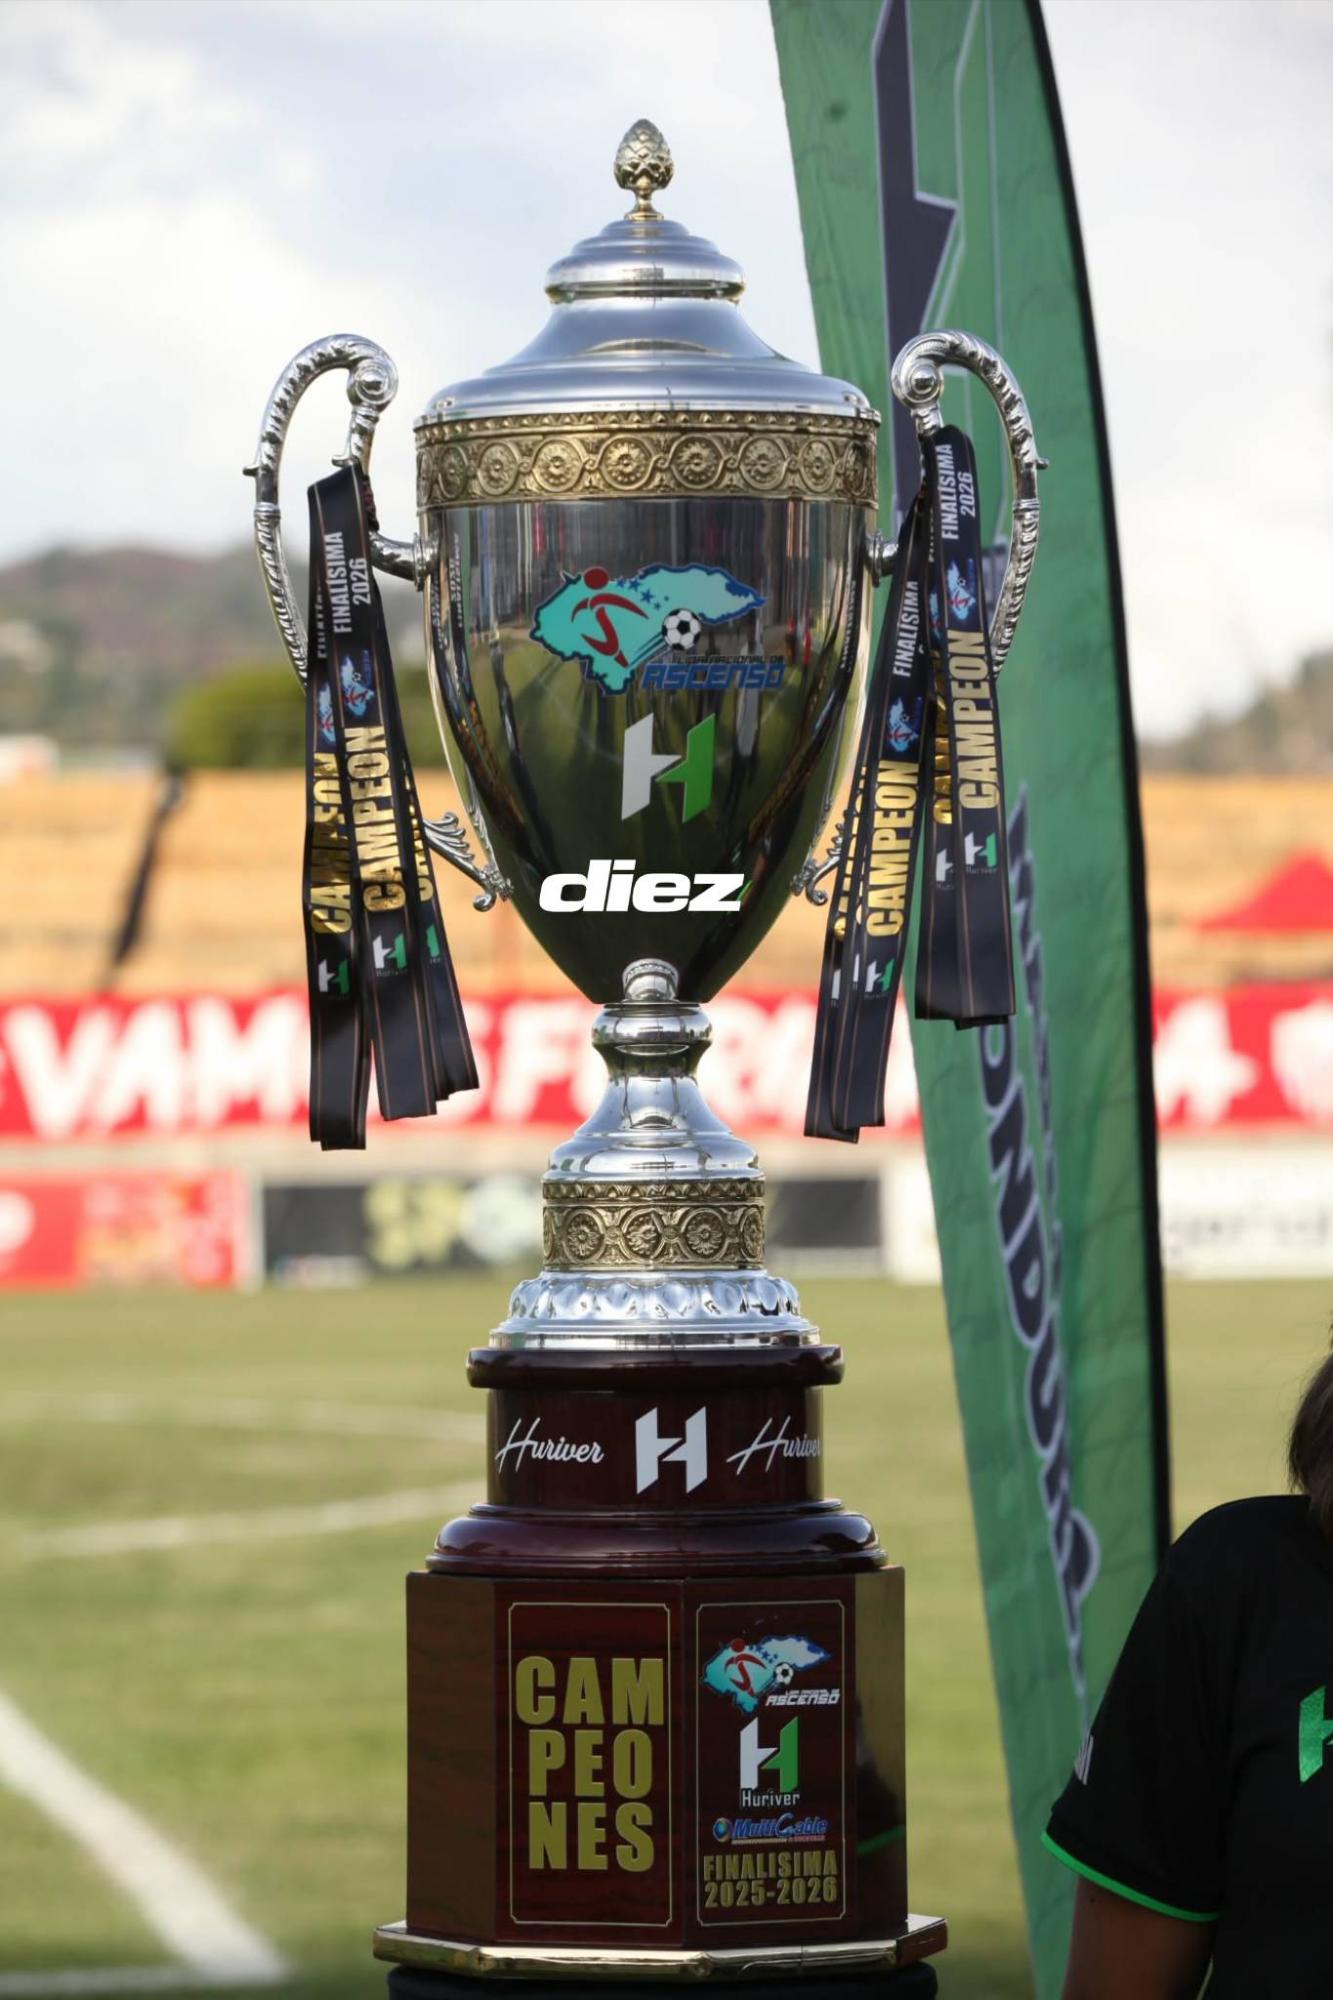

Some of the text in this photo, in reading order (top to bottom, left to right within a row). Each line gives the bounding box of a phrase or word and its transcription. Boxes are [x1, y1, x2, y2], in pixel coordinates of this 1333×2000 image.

[960, 471, 976, 518] 2026
[323, 531, 352, 634] FINALÍSIMA
[350, 557, 372, 606] 2026
[641, 662, 787, 690] ASCENSO
[946, 629, 1000, 809] CAMPEON
[343, 725, 406, 913] CAMPEON
[866, 760, 920, 937] CAMPEON
[495, 1416, 605, 1475] Huriver
[515, 1655, 664, 1726] CAM
[765, 1692, 841, 1706] ASCENSO
[528, 1728, 653, 1800] PEO
[741, 1789, 800, 1808] Huriver
[528, 1801, 655, 1873] NES
[703, 1850, 838, 1881] FINALISIMA
[704, 1876, 838, 1908] 2025-2026
